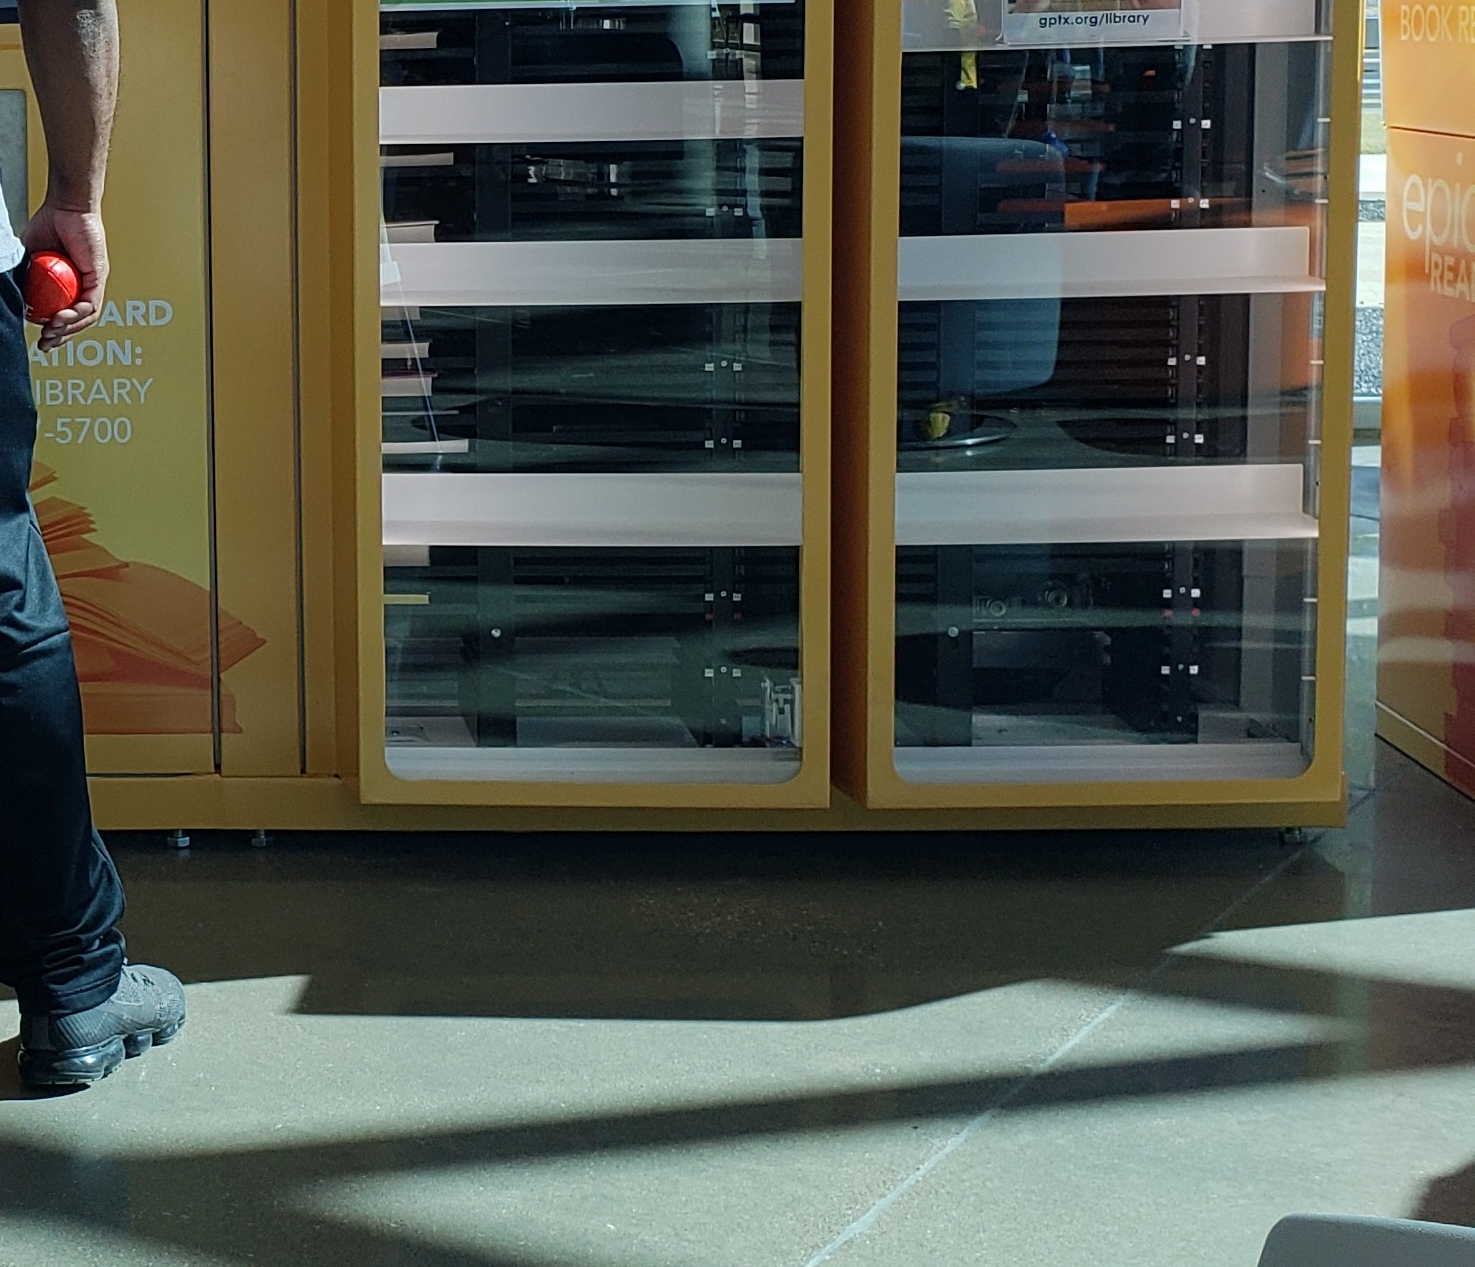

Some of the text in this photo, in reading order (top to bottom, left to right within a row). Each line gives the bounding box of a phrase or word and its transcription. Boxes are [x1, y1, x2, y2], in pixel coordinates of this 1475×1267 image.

[1038, 12, 1151, 29] gptx.org/library
[1400, 3, 1453, 43] BOOK
[1430, 251, 1475, 304] REA
[97, 299, 173, 327] ARD
[35, 377, 154, 406] IBRARY
[43, 417, 132, 445] -5700
